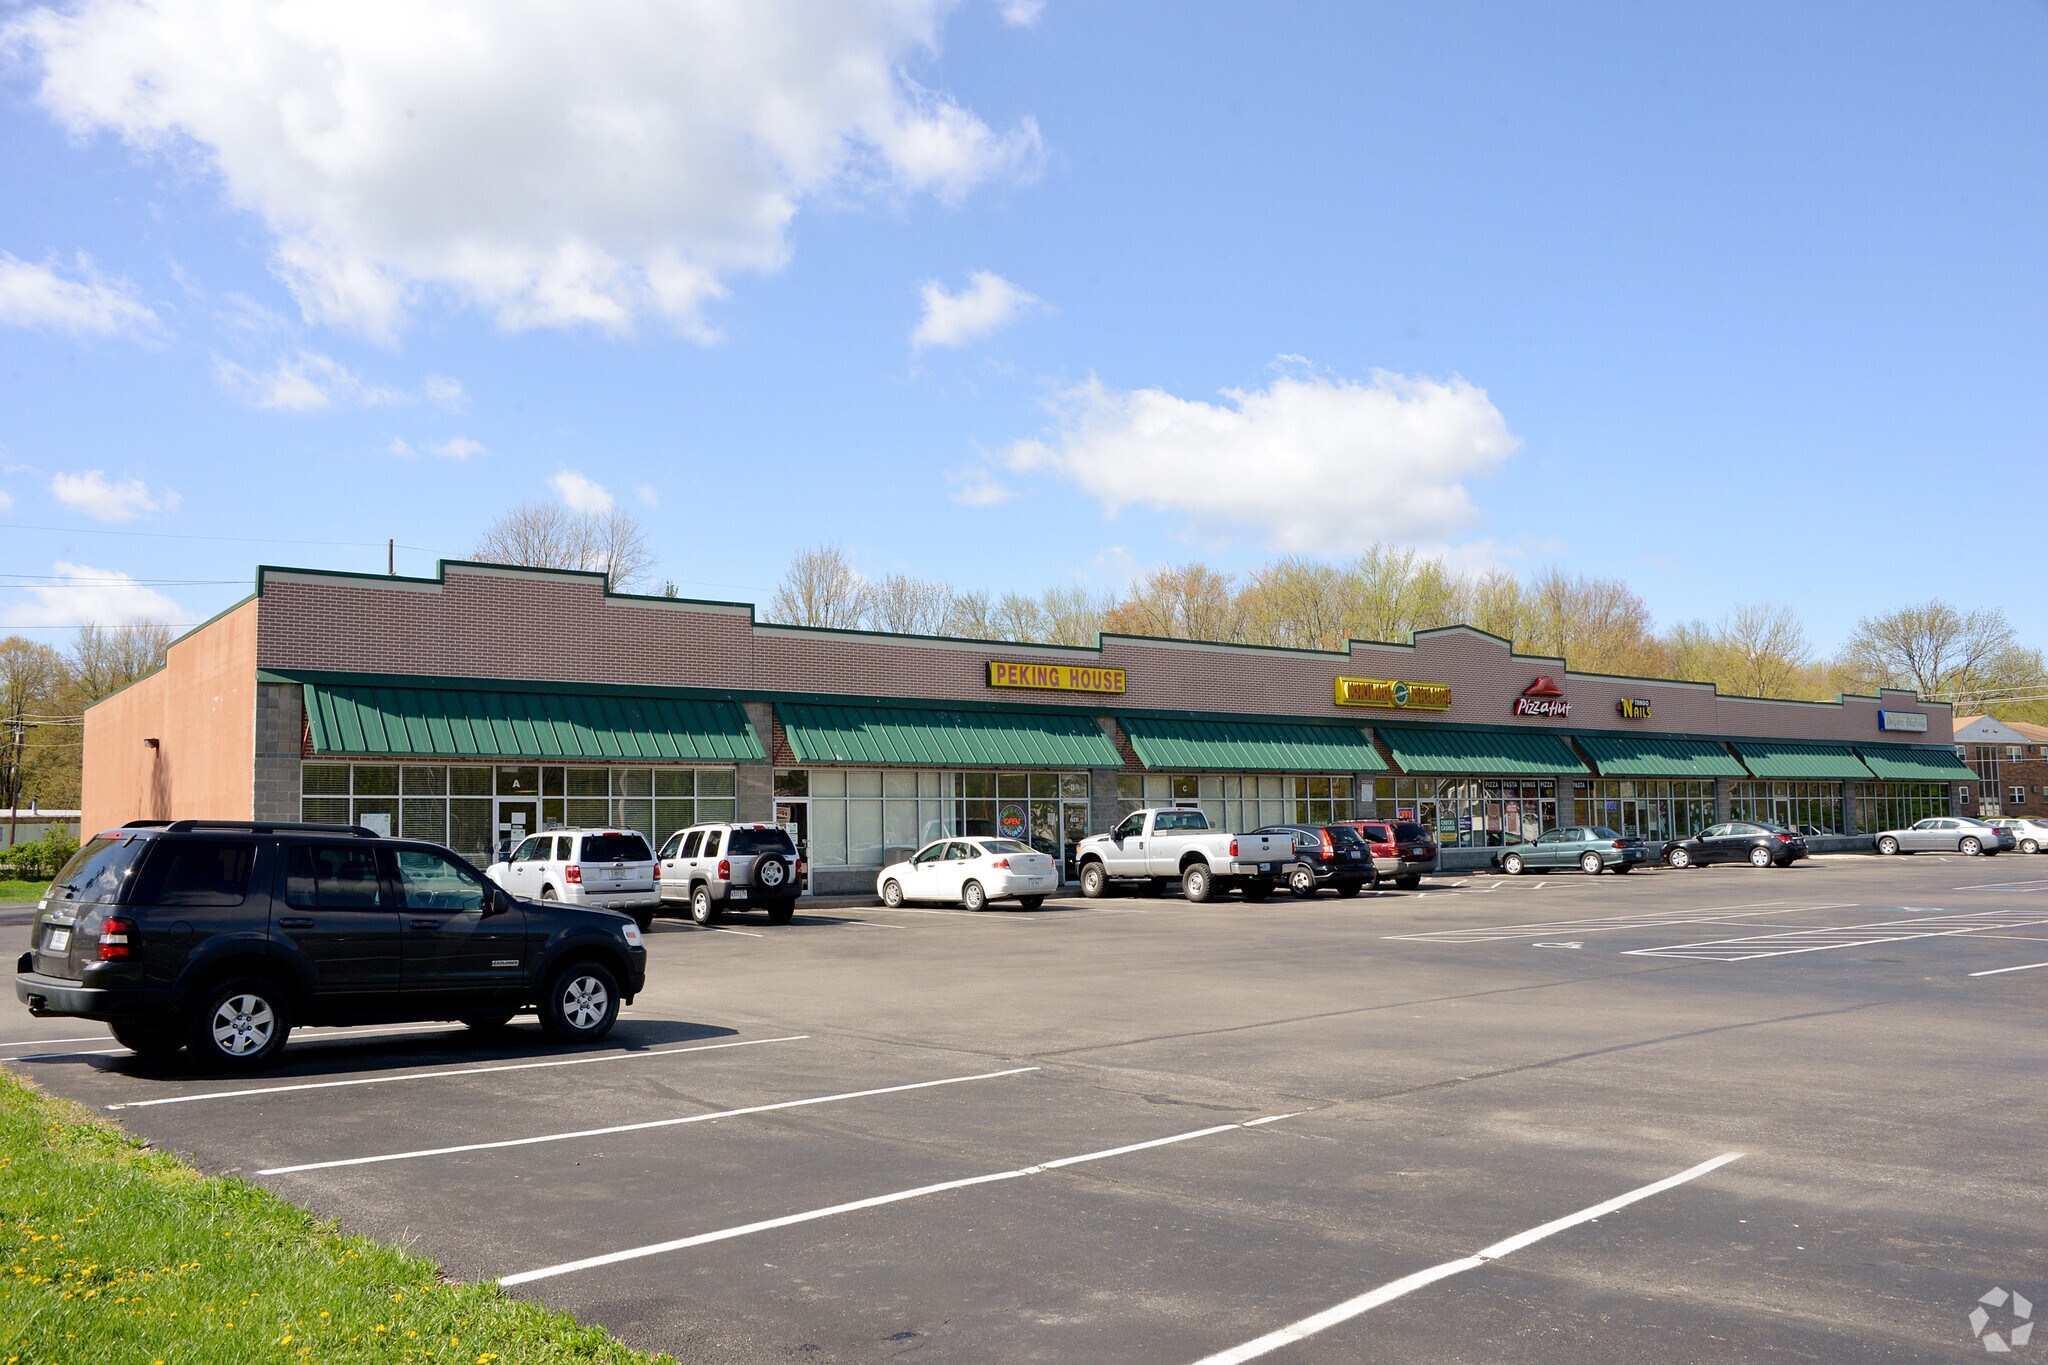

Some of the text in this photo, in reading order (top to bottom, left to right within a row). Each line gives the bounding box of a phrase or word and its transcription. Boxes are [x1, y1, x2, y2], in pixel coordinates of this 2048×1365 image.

[997, 664, 1123, 691] PEKING HOUSE
[513, 780, 521, 788] A
[1004, 817, 1021, 825] OPEN
